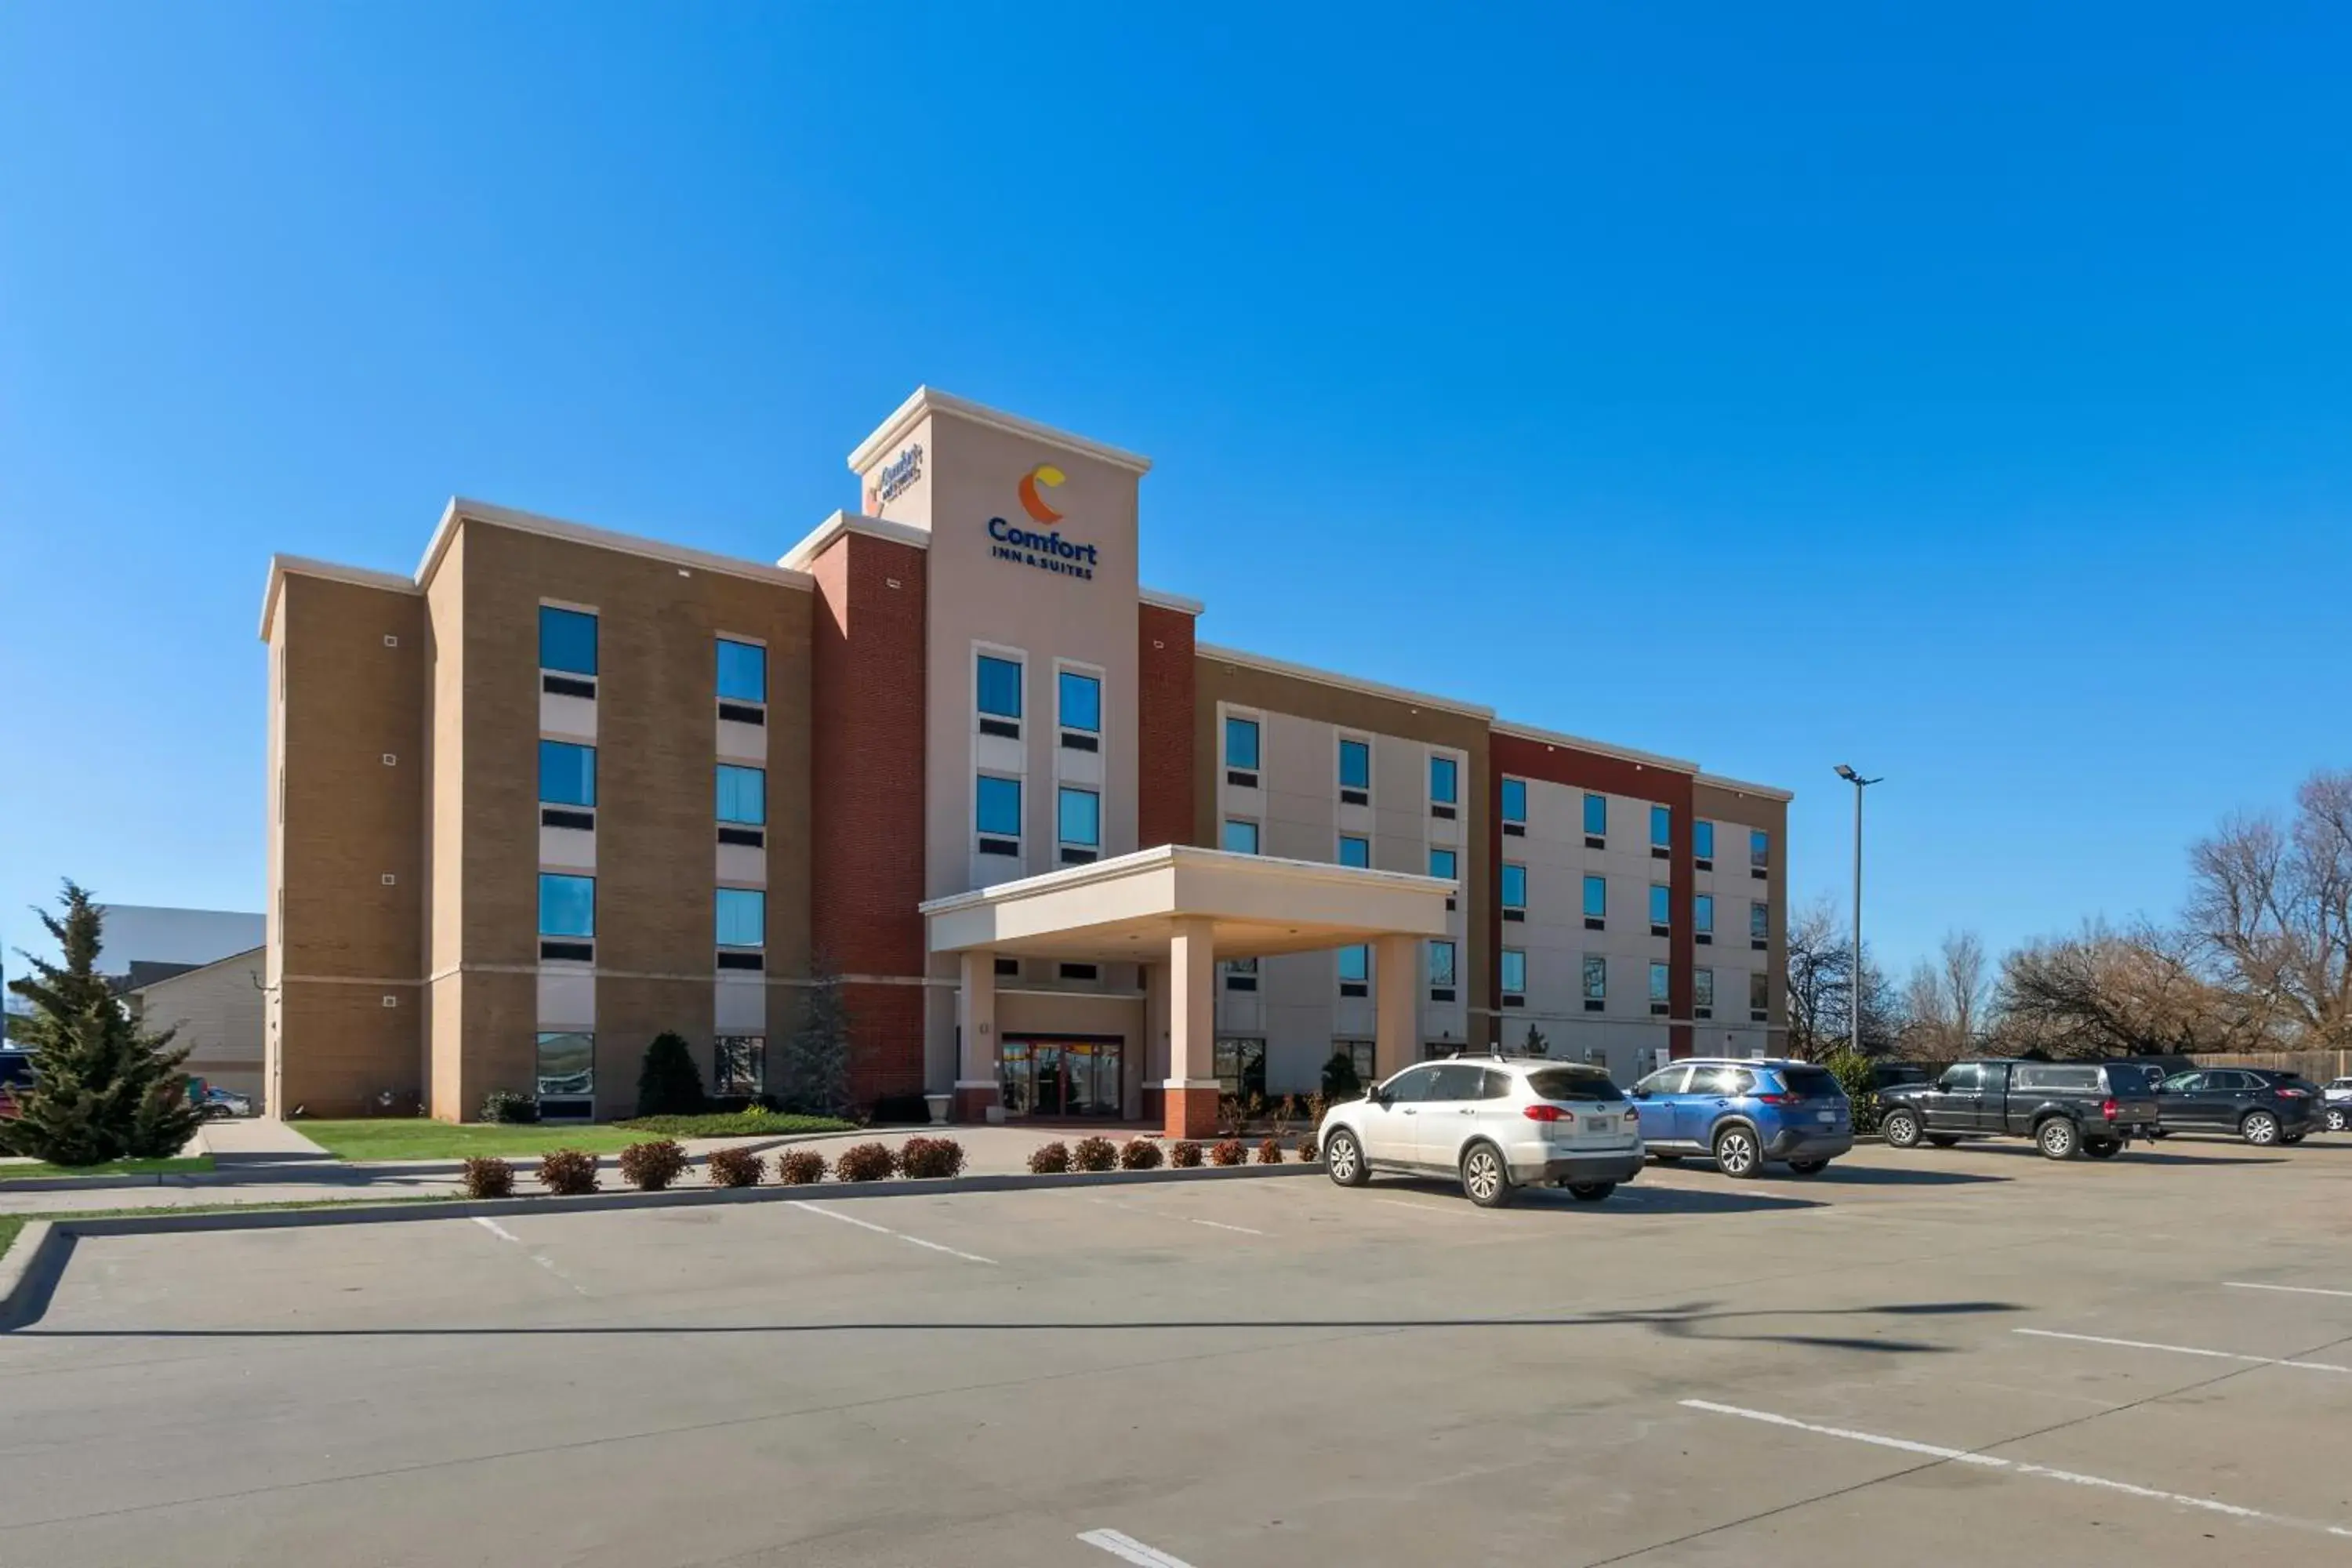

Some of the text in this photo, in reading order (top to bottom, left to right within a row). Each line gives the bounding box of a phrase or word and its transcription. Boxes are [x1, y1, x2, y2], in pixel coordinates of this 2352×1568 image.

[989, 517, 1097, 566] Comfort
[992, 546, 1092, 581] INN & SUITES
